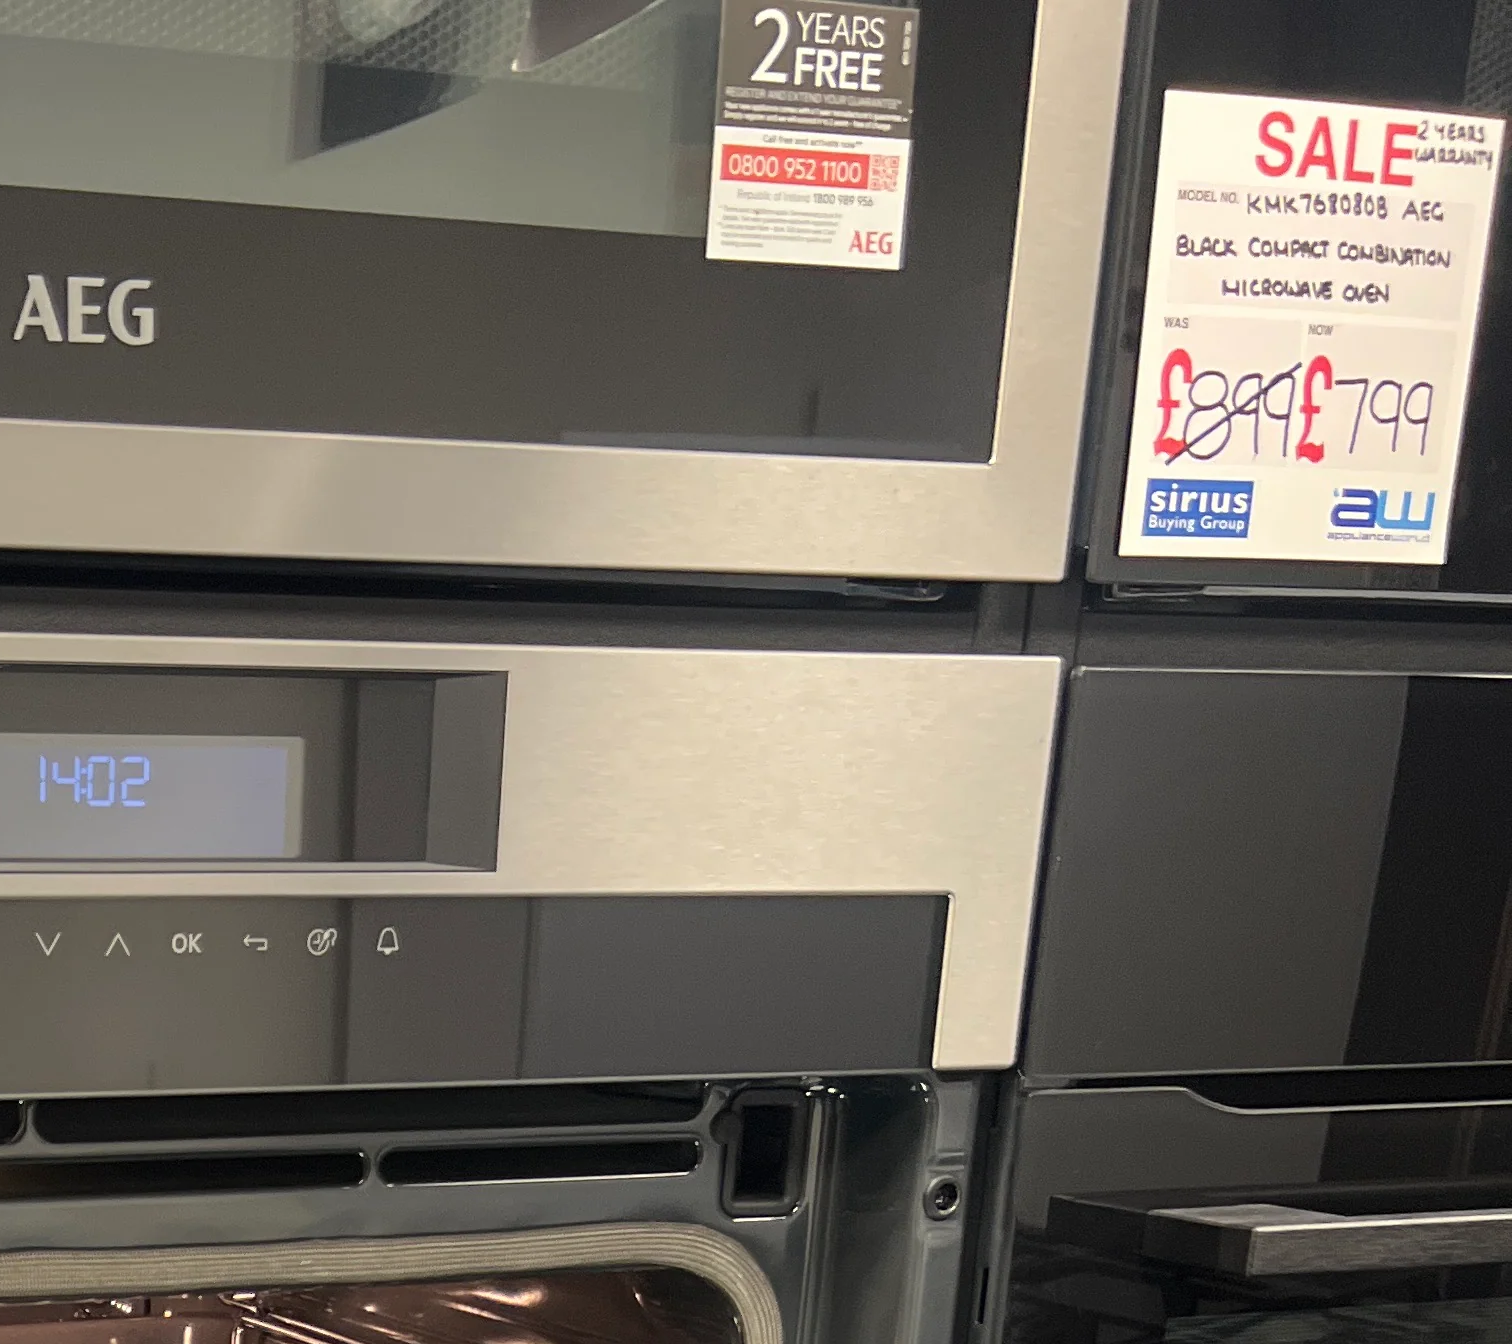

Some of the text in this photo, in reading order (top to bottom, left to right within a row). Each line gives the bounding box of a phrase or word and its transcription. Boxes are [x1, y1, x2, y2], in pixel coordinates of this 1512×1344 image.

[751, 8, 789, 84] 2
[796, 11, 886, 49] YEARS
[793, 47, 885, 92] FREE
[1255, 110, 1419, 186] SALE
[1418, 121, 1487, 144] 2 YEARS
[728, 153, 862, 184] 0800 952 1100
[1415, 147, 1494, 170] WARRANTY
[1177, 188, 1217, 203] MODEL
[1401, 200, 1445, 222] AEG
[848, 231, 894, 255] AEG
[1175, 234, 1452, 269] BLACK COMPACT COMBINATION
[1221, 278, 1391, 304] MICROWAVE OVEN
[12, 273, 156, 346] AEG
[1163, 316, 1189, 330] WAS
[1307, 323, 1334, 337] NOW
[1295, 354, 1434, 463] £799
[1149, 483, 1249, 515] sirius
[1148, 513, 1245, 534] Buying Group
[39, 754, 151, 808] 14:02
[170, 932, 204, 956] OK
